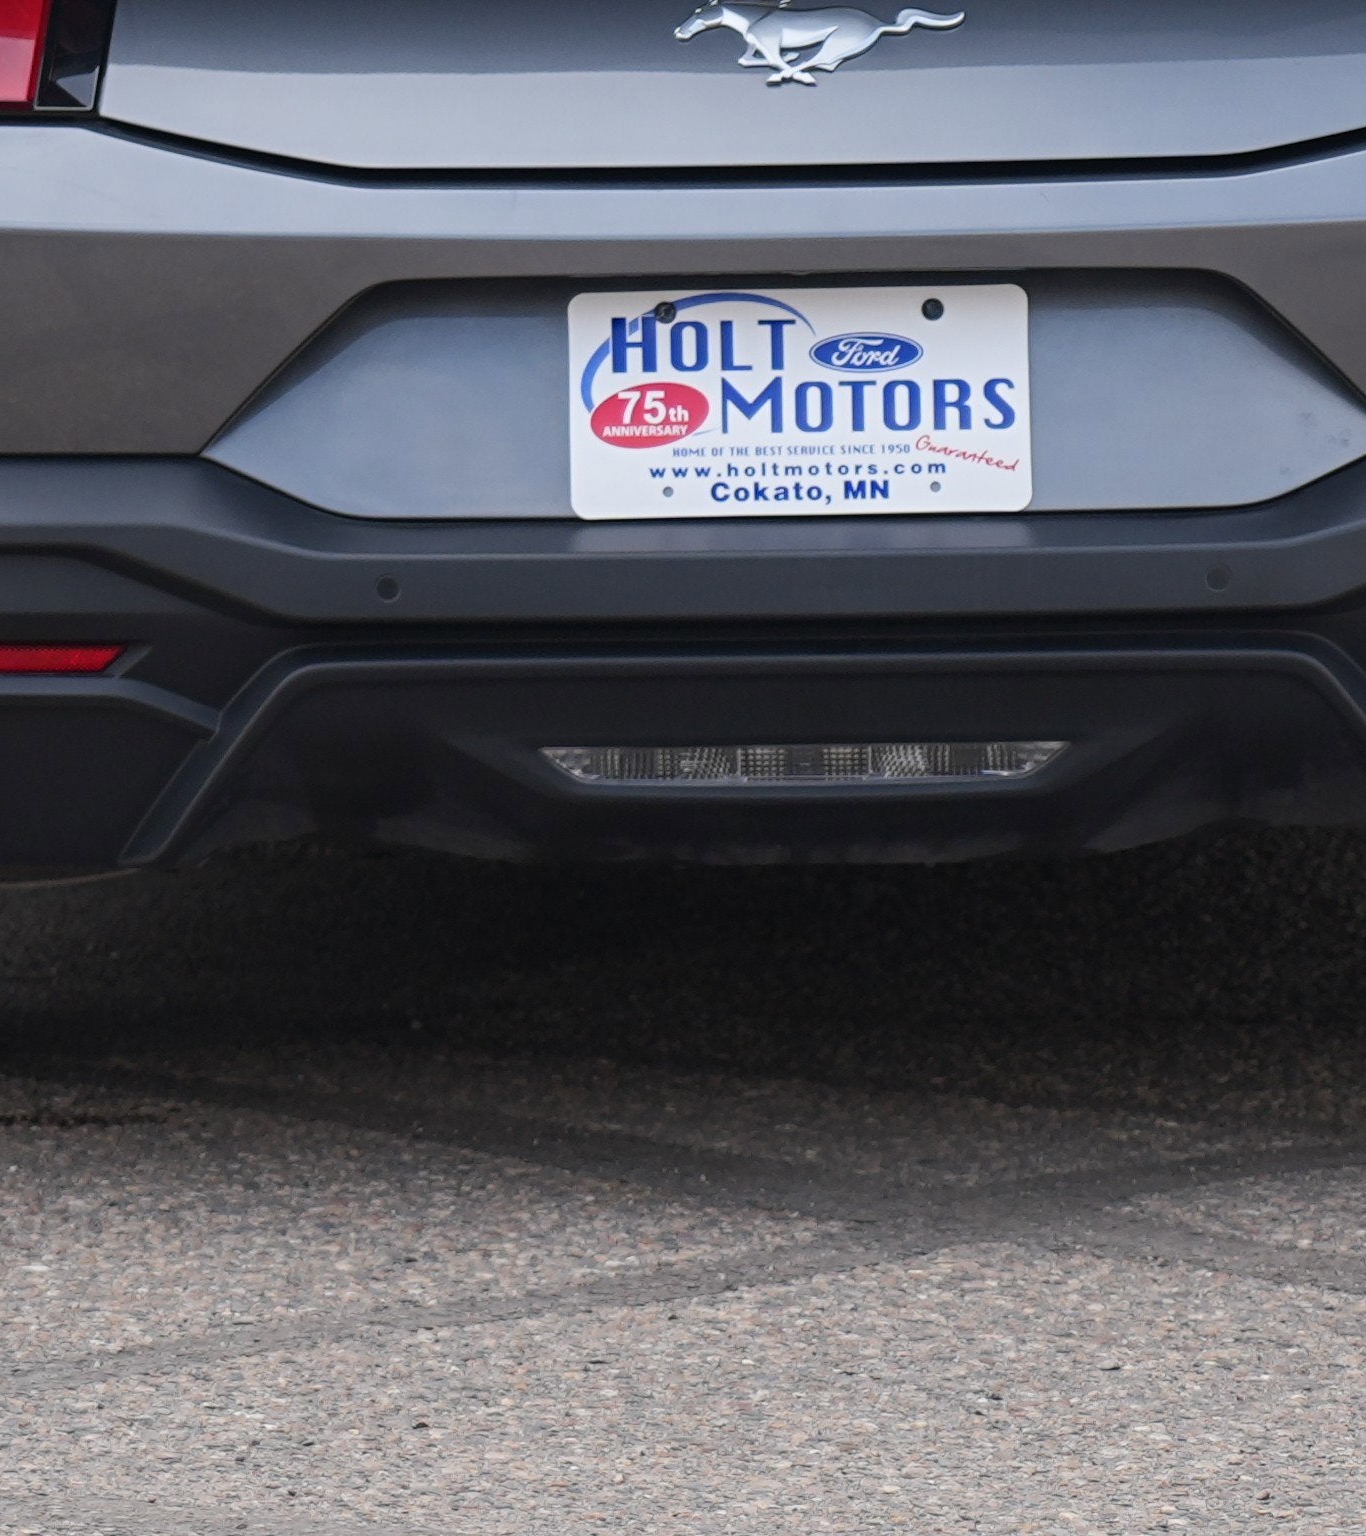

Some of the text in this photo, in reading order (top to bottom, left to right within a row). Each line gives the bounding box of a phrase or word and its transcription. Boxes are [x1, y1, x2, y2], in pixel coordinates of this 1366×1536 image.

[611, 317, 796, 373] HOLT
[831, 337, 901, 368] Ford
[617, 390, 689, 425] 75th
[721, 375, 1017, 434] MOTORS
[602, 424, 689, 438] ANNIVERSARY
[672, 447, 707, 457] HOME
[711, 446, 724, 457] OF
[730, 446, 749, 457] THE
[755, 445, 783, 456] BEST
[787, 444, 835, 456] SERVICE
[841, 444, 876, 455] SINCE
[915, 434, 1020, 471] Guaranteed
[649, 462, 947, 479] www.holtmotors.com
[710, 480, 891, 505] Cokato, MN
